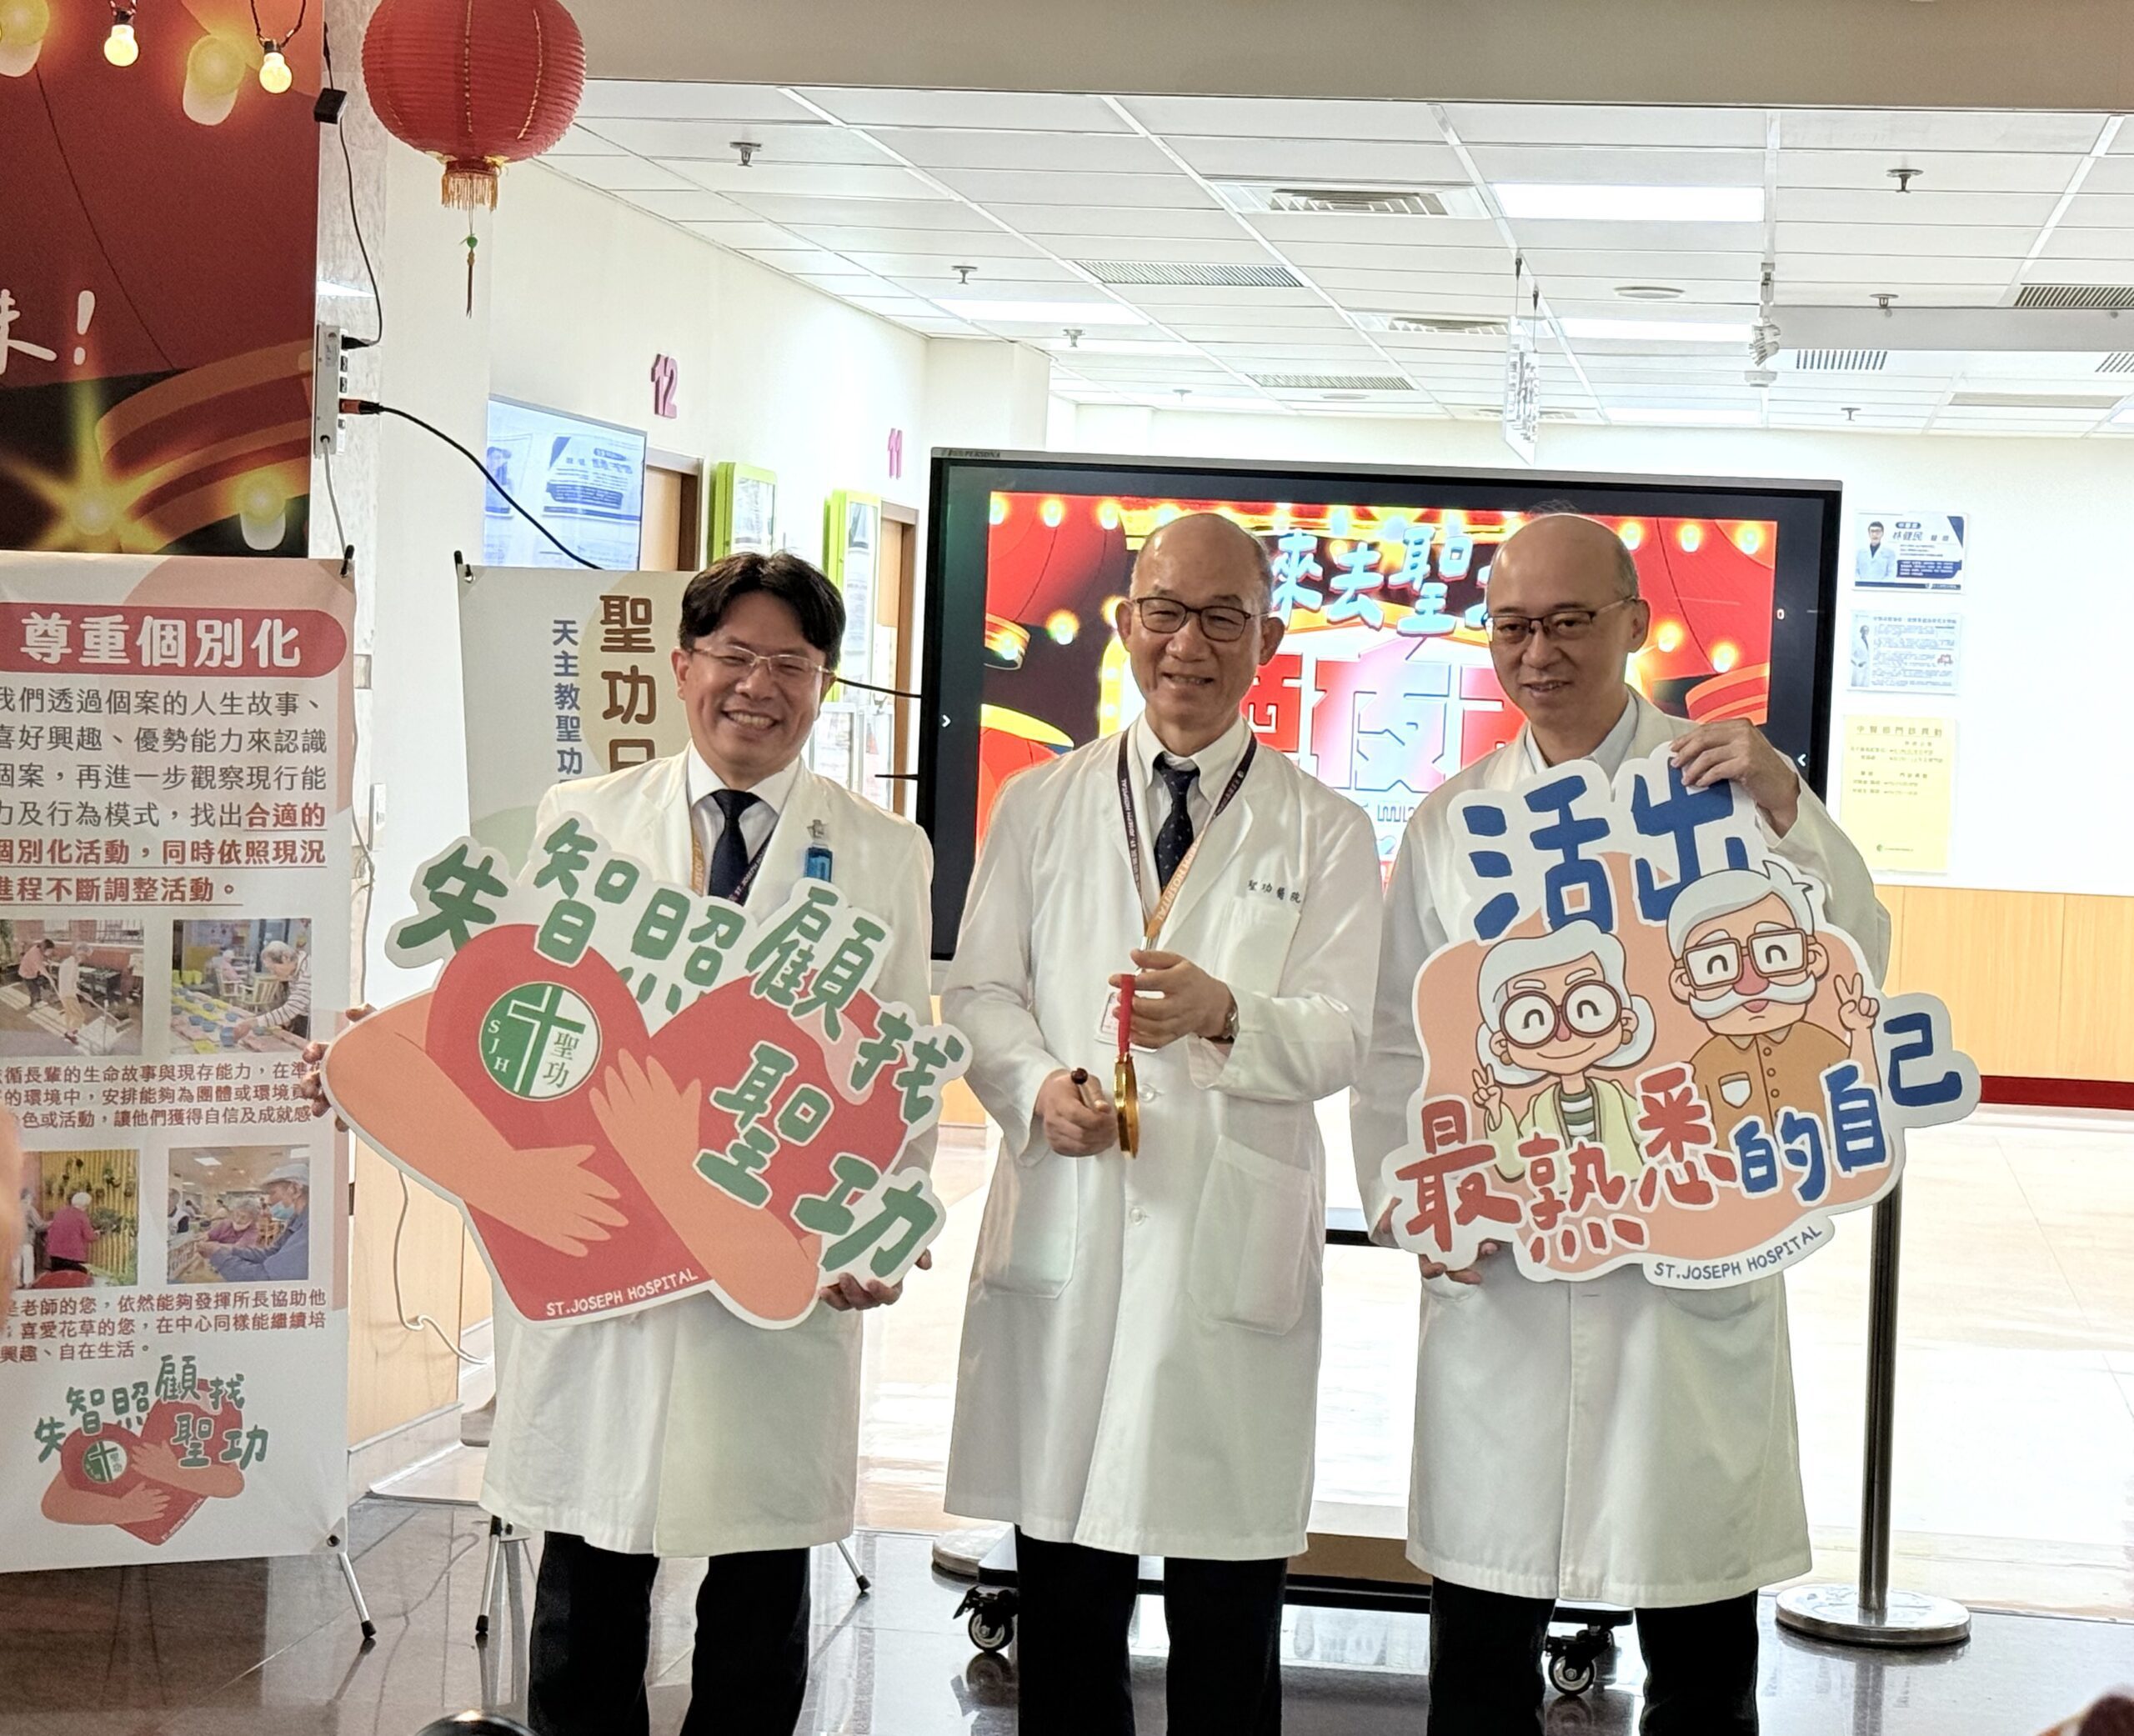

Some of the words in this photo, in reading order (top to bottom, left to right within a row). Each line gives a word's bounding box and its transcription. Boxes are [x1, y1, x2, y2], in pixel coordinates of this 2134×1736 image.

[651, 353, 678, 419] 12
[888, 428, 903, 480] 11
[1265, 527, 1494, 638] 來去聖
[20, 611, 302, 668] 尊重個別化
[552, 619, 584, 783] 天主教聖功
[1462, 750, 1752, 940] 活出
[543, 1032, 579, 1088] 聖功
[1396, 1011, 1963, 1264] 最熟悉的自己
[1654, 1260, 1742, 1280] ST.JOSEPH
[1746, 1226, 1822, 1272] HOSPITAL
[546, 1290, 623, 1316] ST.JOSEPH
[627, 1268, 698, 1301] HOSPITAL
